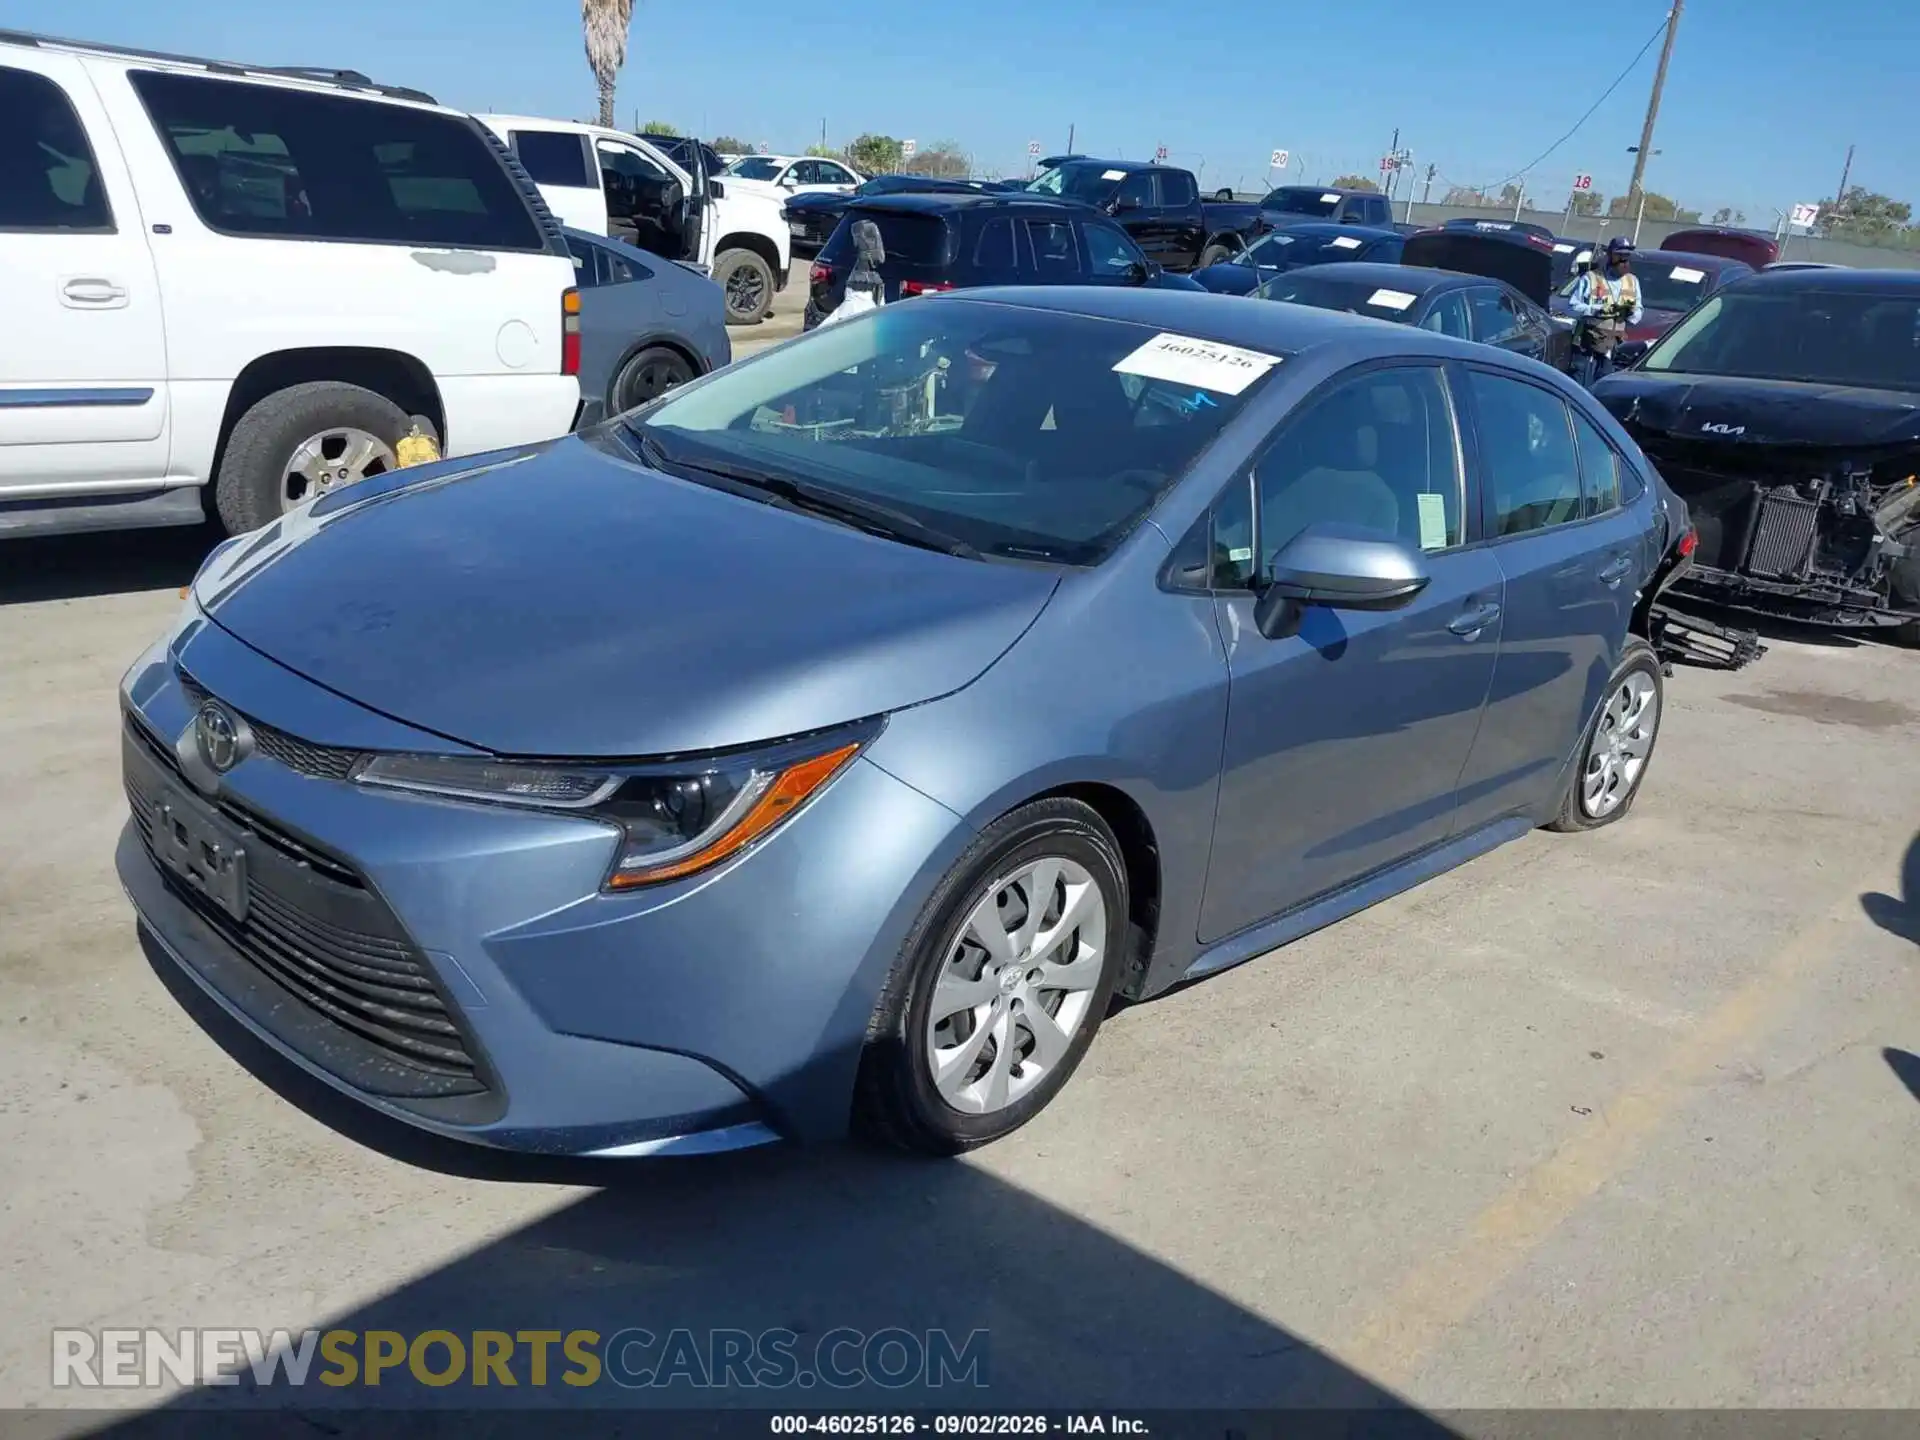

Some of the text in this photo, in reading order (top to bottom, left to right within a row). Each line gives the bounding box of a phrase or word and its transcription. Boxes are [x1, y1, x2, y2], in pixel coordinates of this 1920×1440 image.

[1272, 152, 1287, 165] 20
[1379, 158, 1394, 170] 19
[1573, 175, 1592, 189] 18
[1791, 207, 1816, 222] 17
